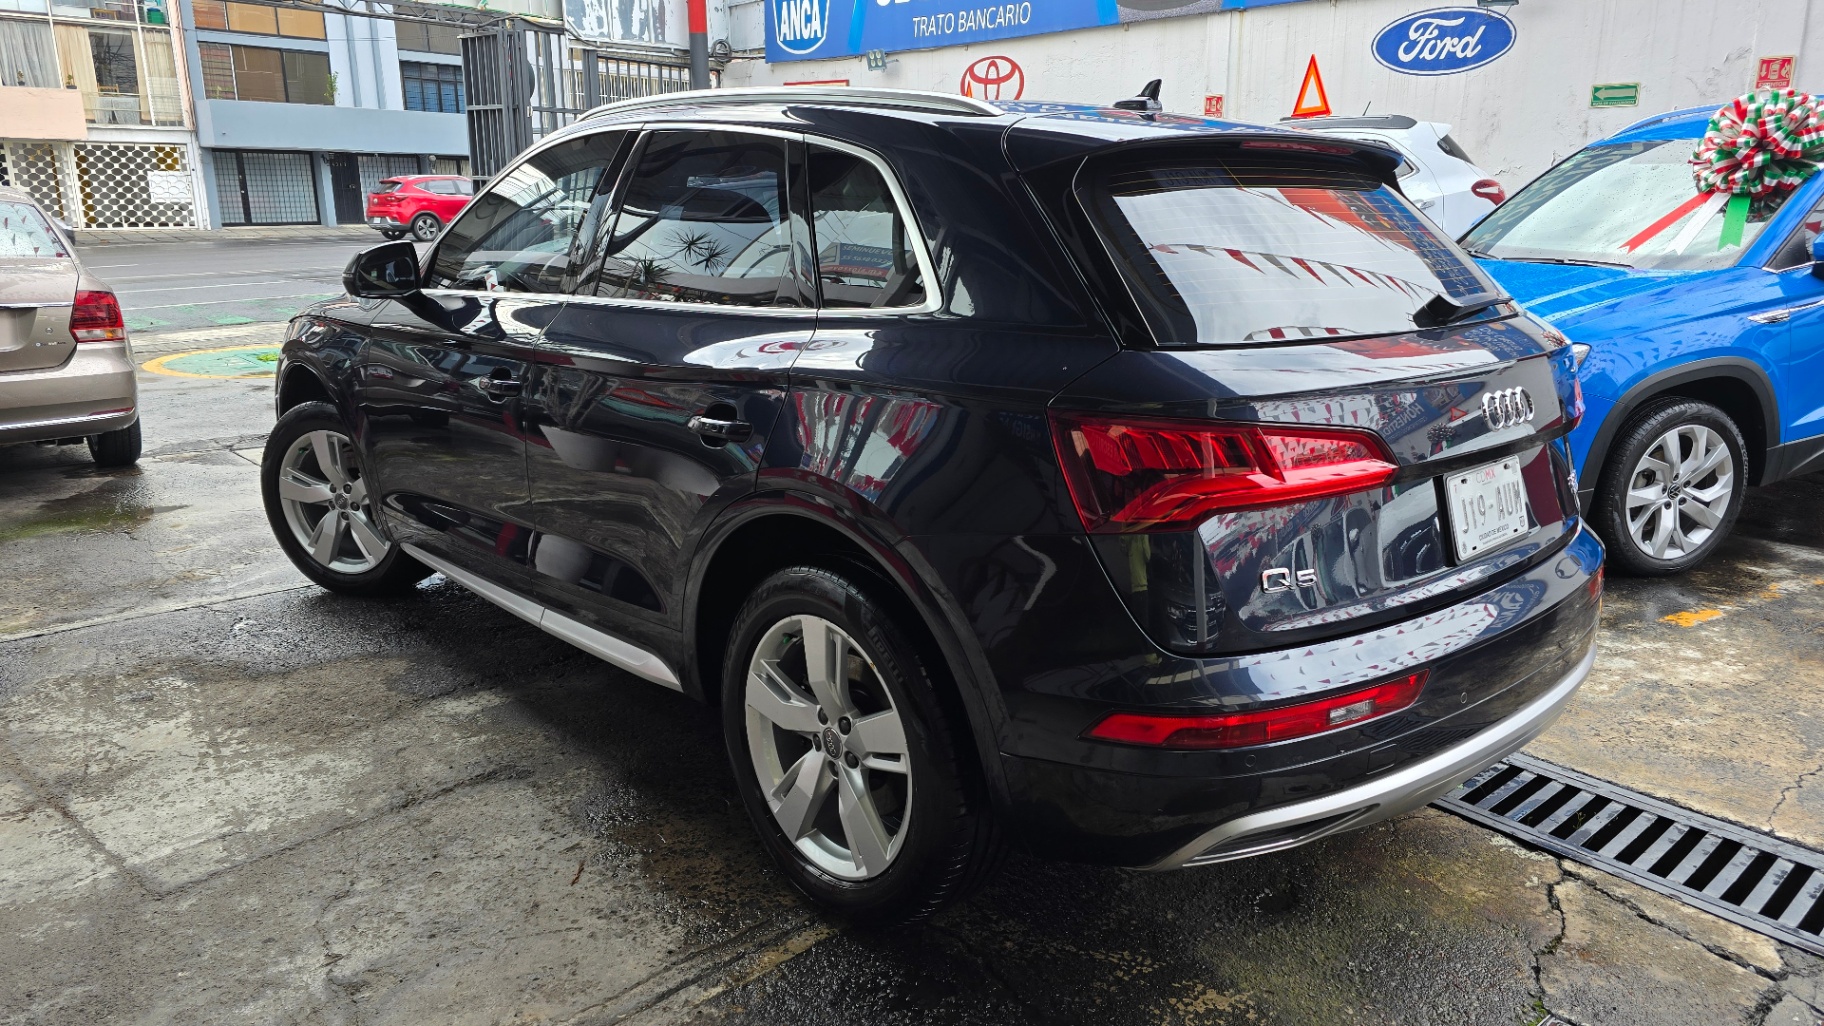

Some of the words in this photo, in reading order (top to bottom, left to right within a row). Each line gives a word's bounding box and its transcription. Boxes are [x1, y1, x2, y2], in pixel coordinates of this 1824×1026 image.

[780, 0, 822, 42] ANCA
[912, 13, 955, 38] TRATO
[958, 1, 1032, 33] BANCARIO
[1397, 16, 1487, 63] Ford
[1262, 567, 1318, 594] Q5
